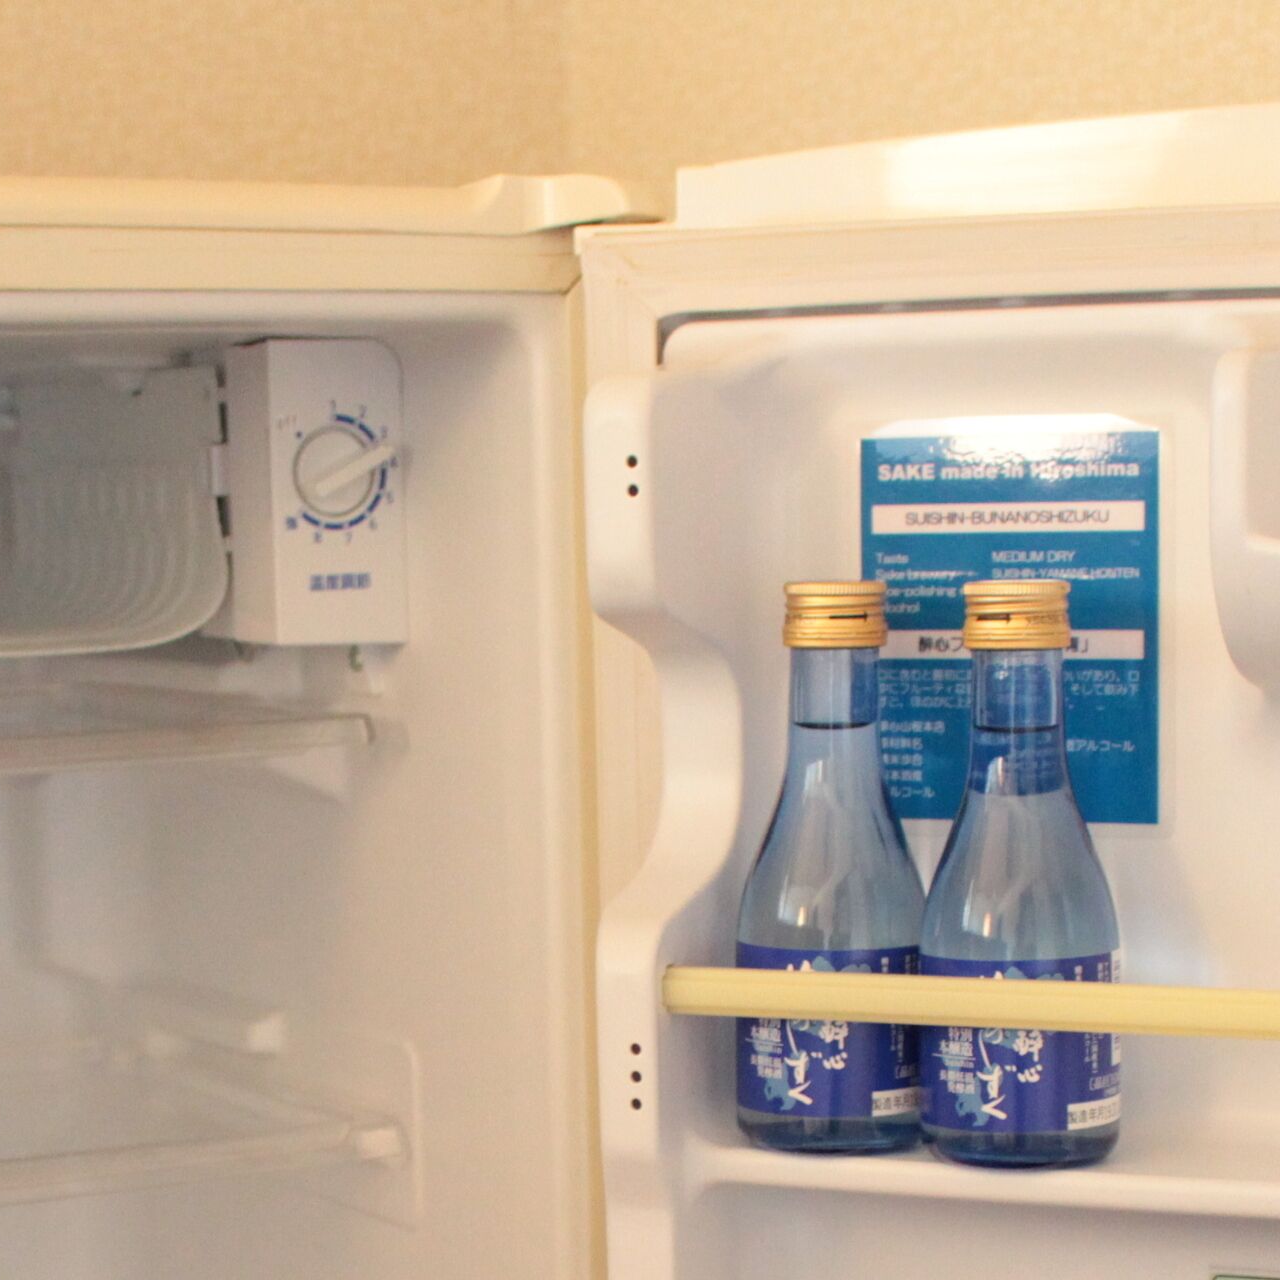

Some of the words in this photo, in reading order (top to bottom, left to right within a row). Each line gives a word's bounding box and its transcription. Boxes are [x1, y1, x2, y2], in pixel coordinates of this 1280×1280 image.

[878, 463, 935, 482] SAKE
[941, 463, 993, 481] made
[1002, 463, 1024, 479] in
[1031, 461, 1140, 479] Hiroshima
[905, 509, 1111, 527] SUISHIN-BUNANOSHIZUKU
[876, 552, 909, 565] Taste
[992, 551, 1044, 563] MEDIUM
[1047, 551, 1076, 563] DRY
[310, 573, 371, 591] 温度調節
[876, 568, 905, 581] Sake
[907, 568, 957, 582] brewery
[885, 586, 956, 598] ce-polishing
[884, 602, 920, 613] lcohol
[889, 786, 936, 798] ルコール
